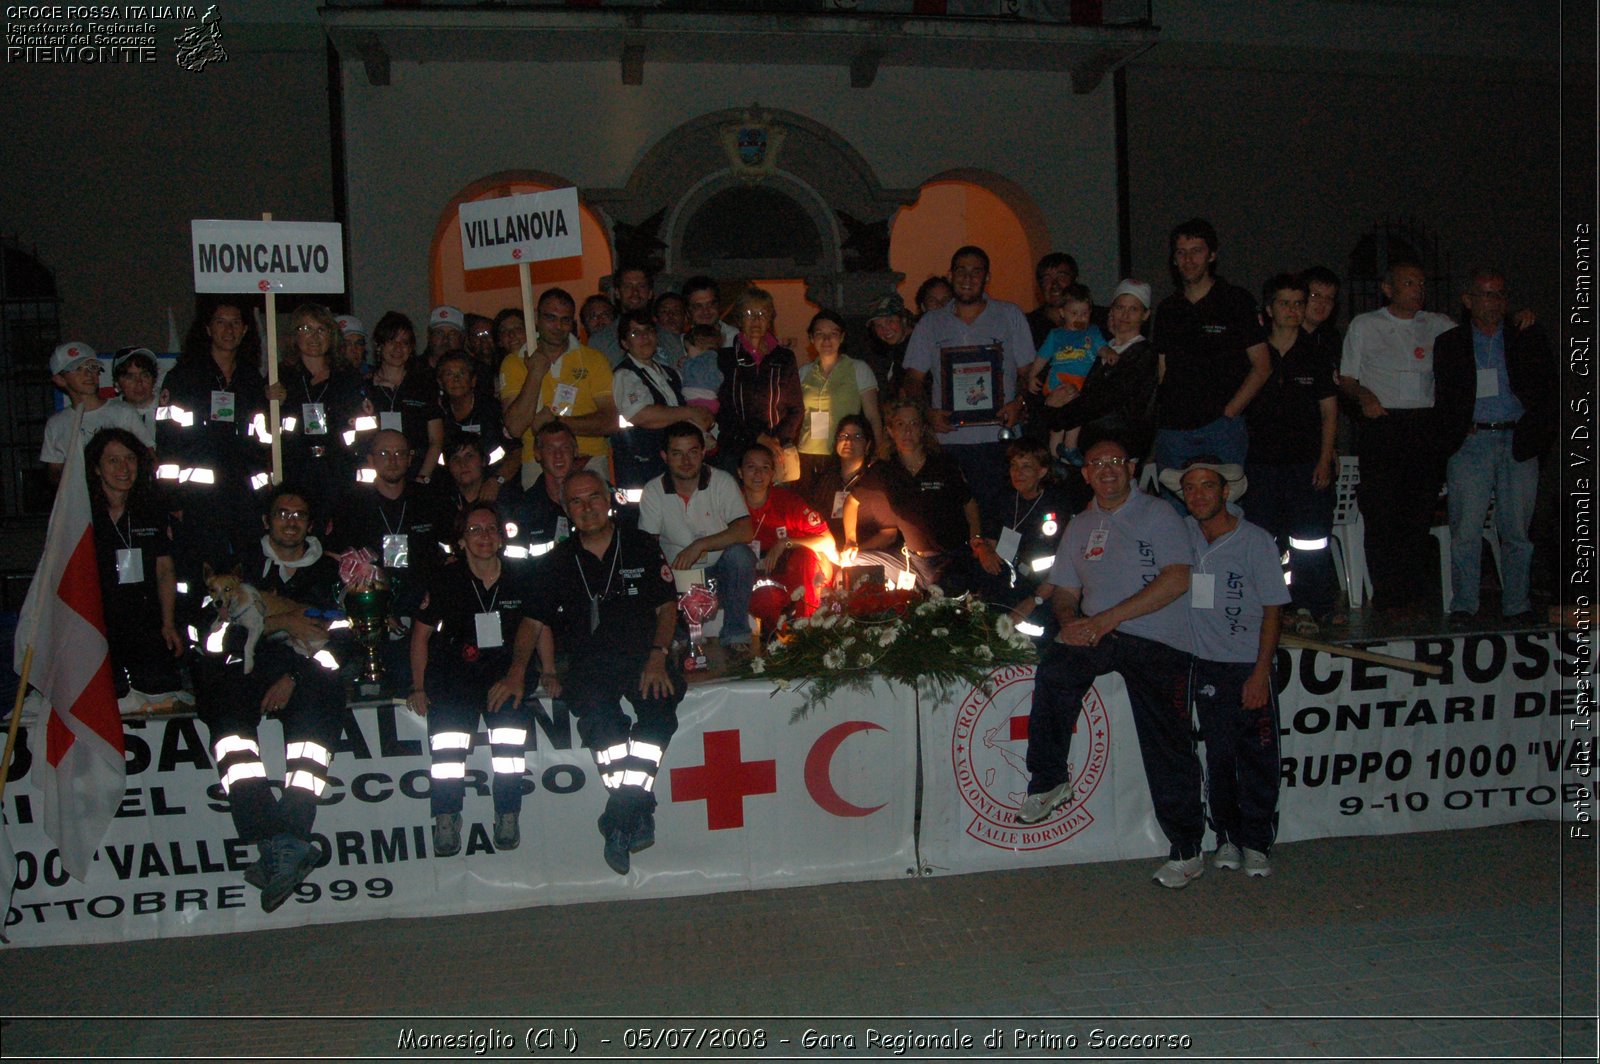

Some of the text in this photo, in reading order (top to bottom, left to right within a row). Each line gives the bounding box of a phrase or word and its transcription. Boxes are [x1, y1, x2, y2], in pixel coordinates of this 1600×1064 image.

[464, 208, 568, 248] VILLANOVA
[198, 243, 329, 274] MONCALVO
[1225, 571, 1244, 600] ASTI
[1413, 632, 1597, 687] ROSS
[957, 665, 1037, 739] CROC ROSS
[1280, 694, 1495, 735] ONTARI
[1280, 749, 1412, 788] RUPPO
[1426, 743, 1516, 779] 1000
[1340, 782, 1597, 816] 9-10 OTTOB
[976, 814, 1086, 844] VALLE BORMIDA
[293, 877, 394, 904] 999
